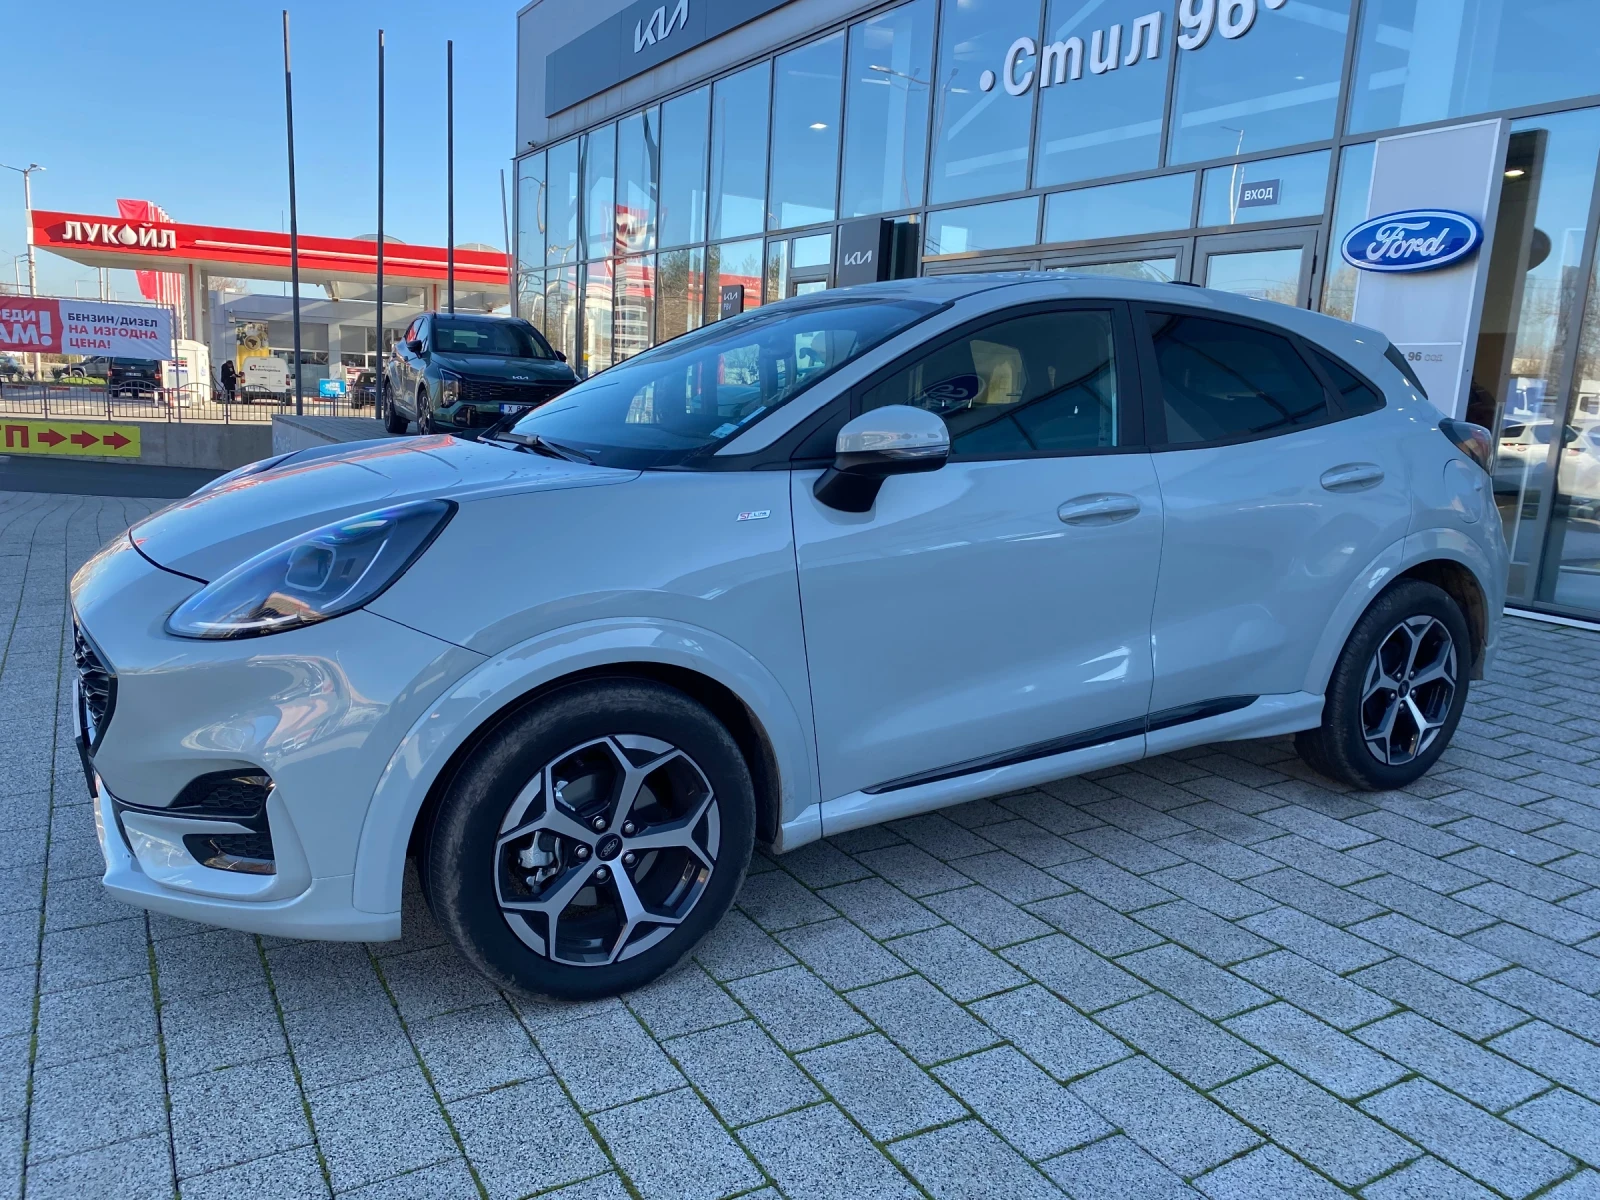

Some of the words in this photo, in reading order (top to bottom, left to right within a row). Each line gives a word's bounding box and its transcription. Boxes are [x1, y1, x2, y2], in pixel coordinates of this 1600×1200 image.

[634, 0, 689, 54] KIA
[1244, 187, 1273, 201] ВХОД
[62, 220, 177, 249] ЛУКОЙЛ
[1366, 221, 1450, 261] Ford
[844, 249, 873, 266] KIA
[723, 291, 738, 301] KIA
[0, 308, 36, 323] ЕДИ
[67, 312, 158, 328] БЕНЗИН/ДИЗЕЛ
[68, 324, 89, 335] НА
[93, 325, 158, 340] ИЗГОДНА
[69, 337, 111, 349] ЦЕНА!
[1408, 351, 1422, 362] 96
